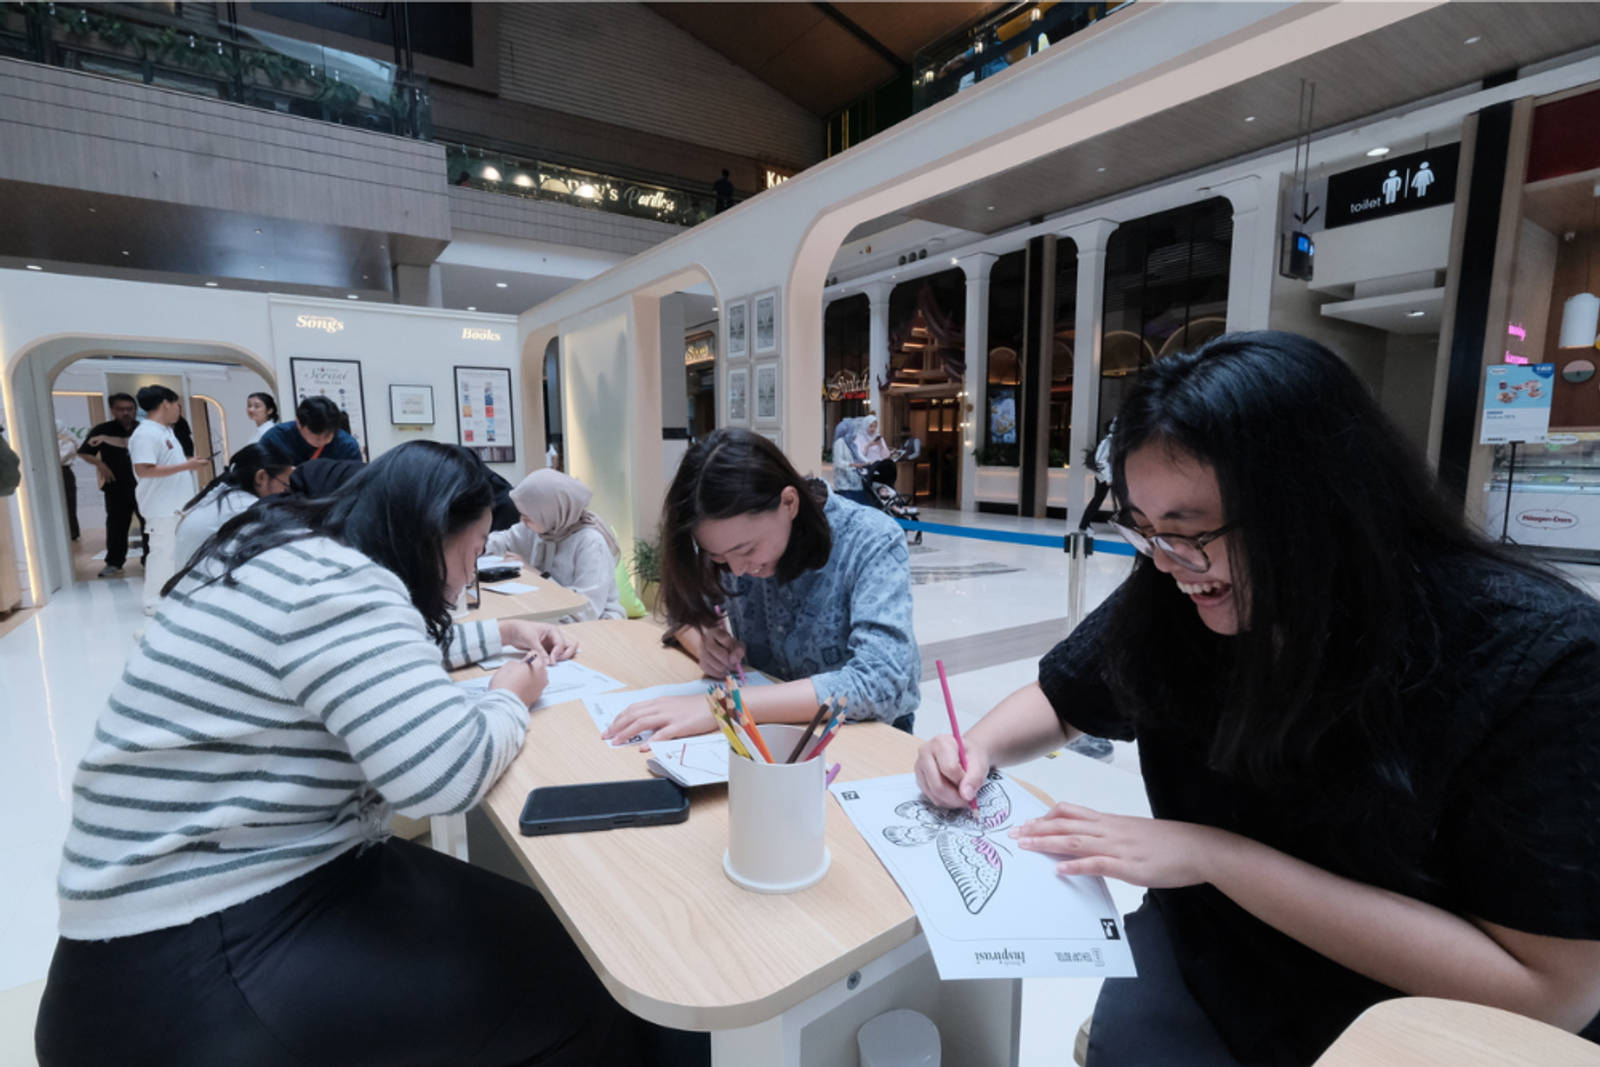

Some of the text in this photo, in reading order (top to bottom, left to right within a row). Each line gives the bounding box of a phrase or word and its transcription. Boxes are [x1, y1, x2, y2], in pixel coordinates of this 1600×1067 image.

[1350, 197, 1381, 213] toilet
[296, 315, 344, 333] Songs
[462, 327, 501, 341] Books
[974, 948, 1026, 964] Inspirasi
